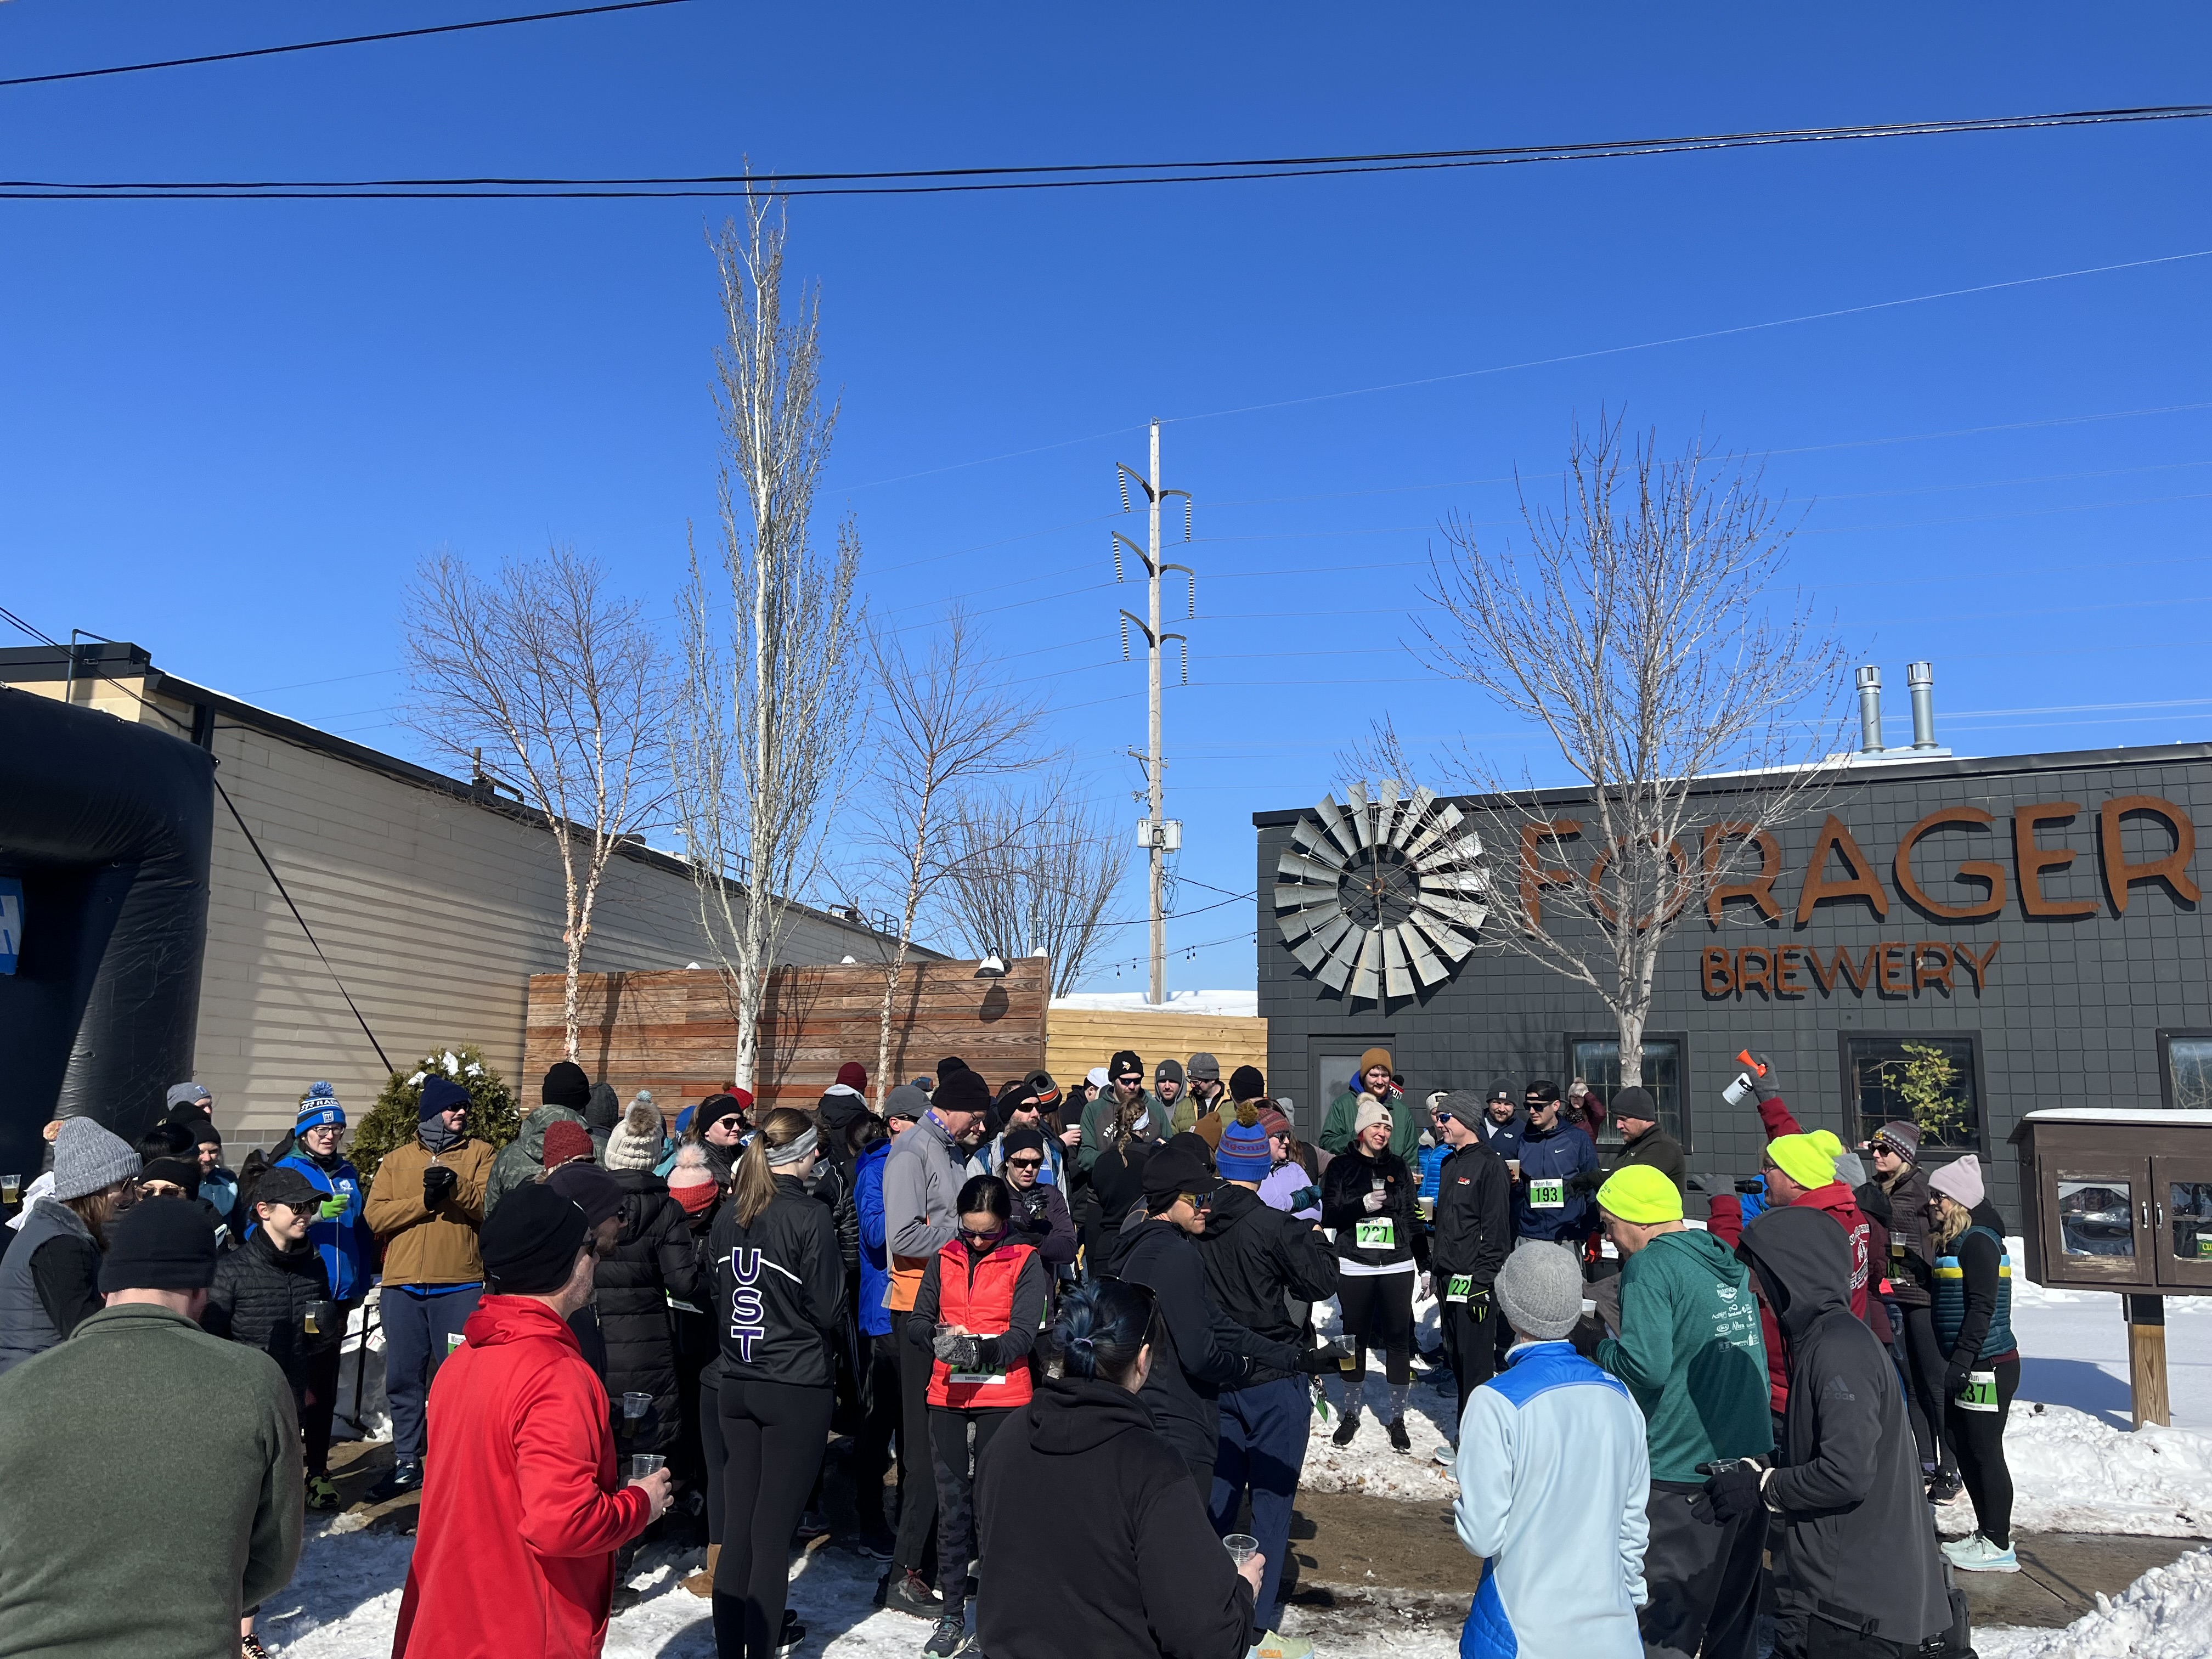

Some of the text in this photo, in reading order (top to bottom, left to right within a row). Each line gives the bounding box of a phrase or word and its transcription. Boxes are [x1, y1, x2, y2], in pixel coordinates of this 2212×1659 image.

[1521, 795, 2202, 928] FORAGER
[1703, 940, 2000, 994] BREWERY
[1536, 1187, 1558, 1203] 193
[1363, 1226, 1388, 1243] 227
[731, 1246, 765, 1363] UST
[1257, 1649, 1283, 1658] HOKA
